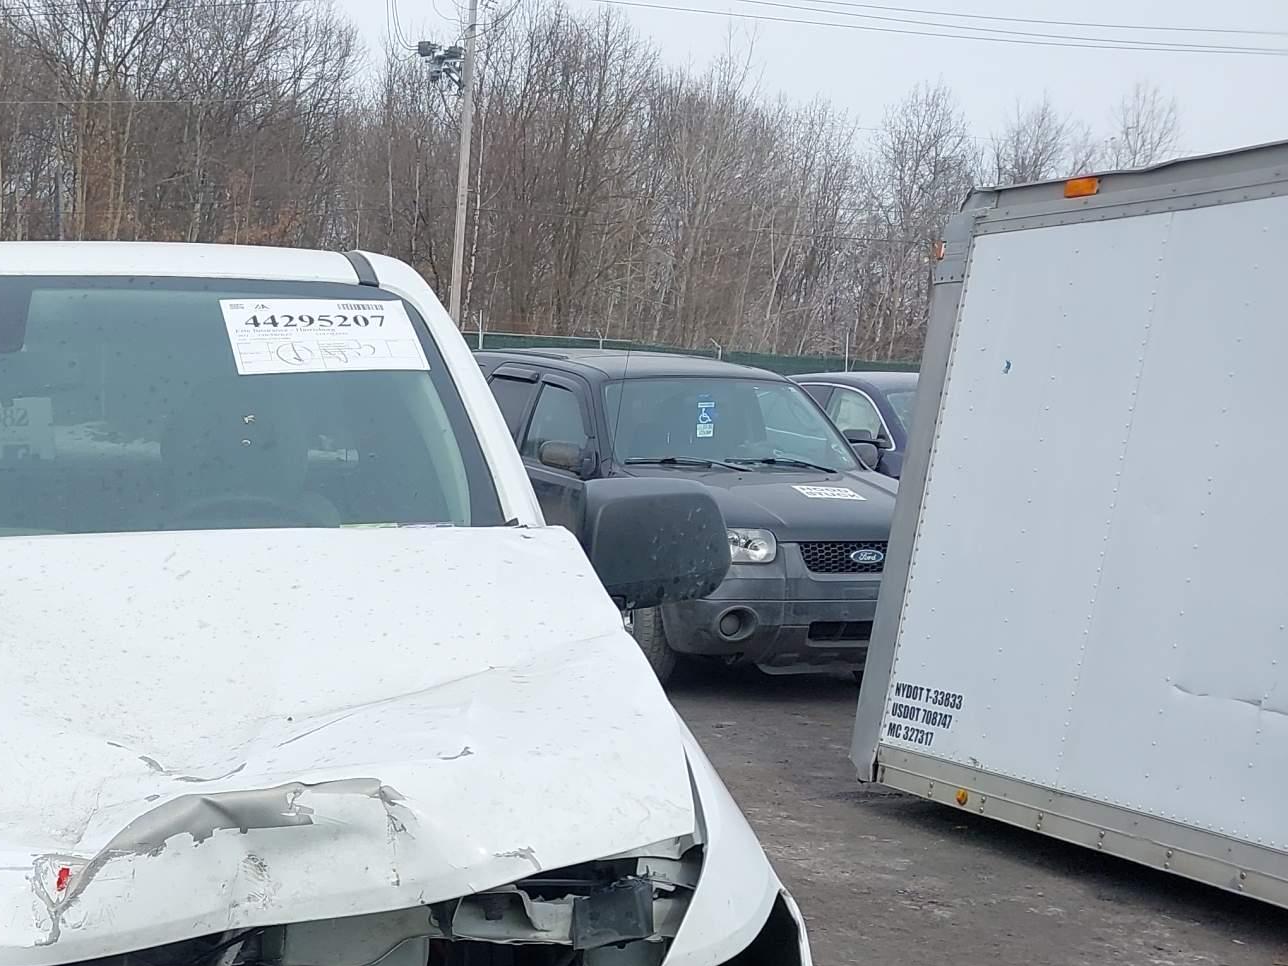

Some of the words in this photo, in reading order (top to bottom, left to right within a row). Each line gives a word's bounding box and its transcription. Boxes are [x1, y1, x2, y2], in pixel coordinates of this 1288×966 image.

[244, 314, 385, 328] 44295207
[895, 682, 924, 702] NYDOT
[925, 688, 963, 710] T-33833
[891, 702, 922, 722] USDOT
[921, 709, 953, 729] 708747
[887, 722, 902, 738] MC
[902, 726, 934, 746] 327317
